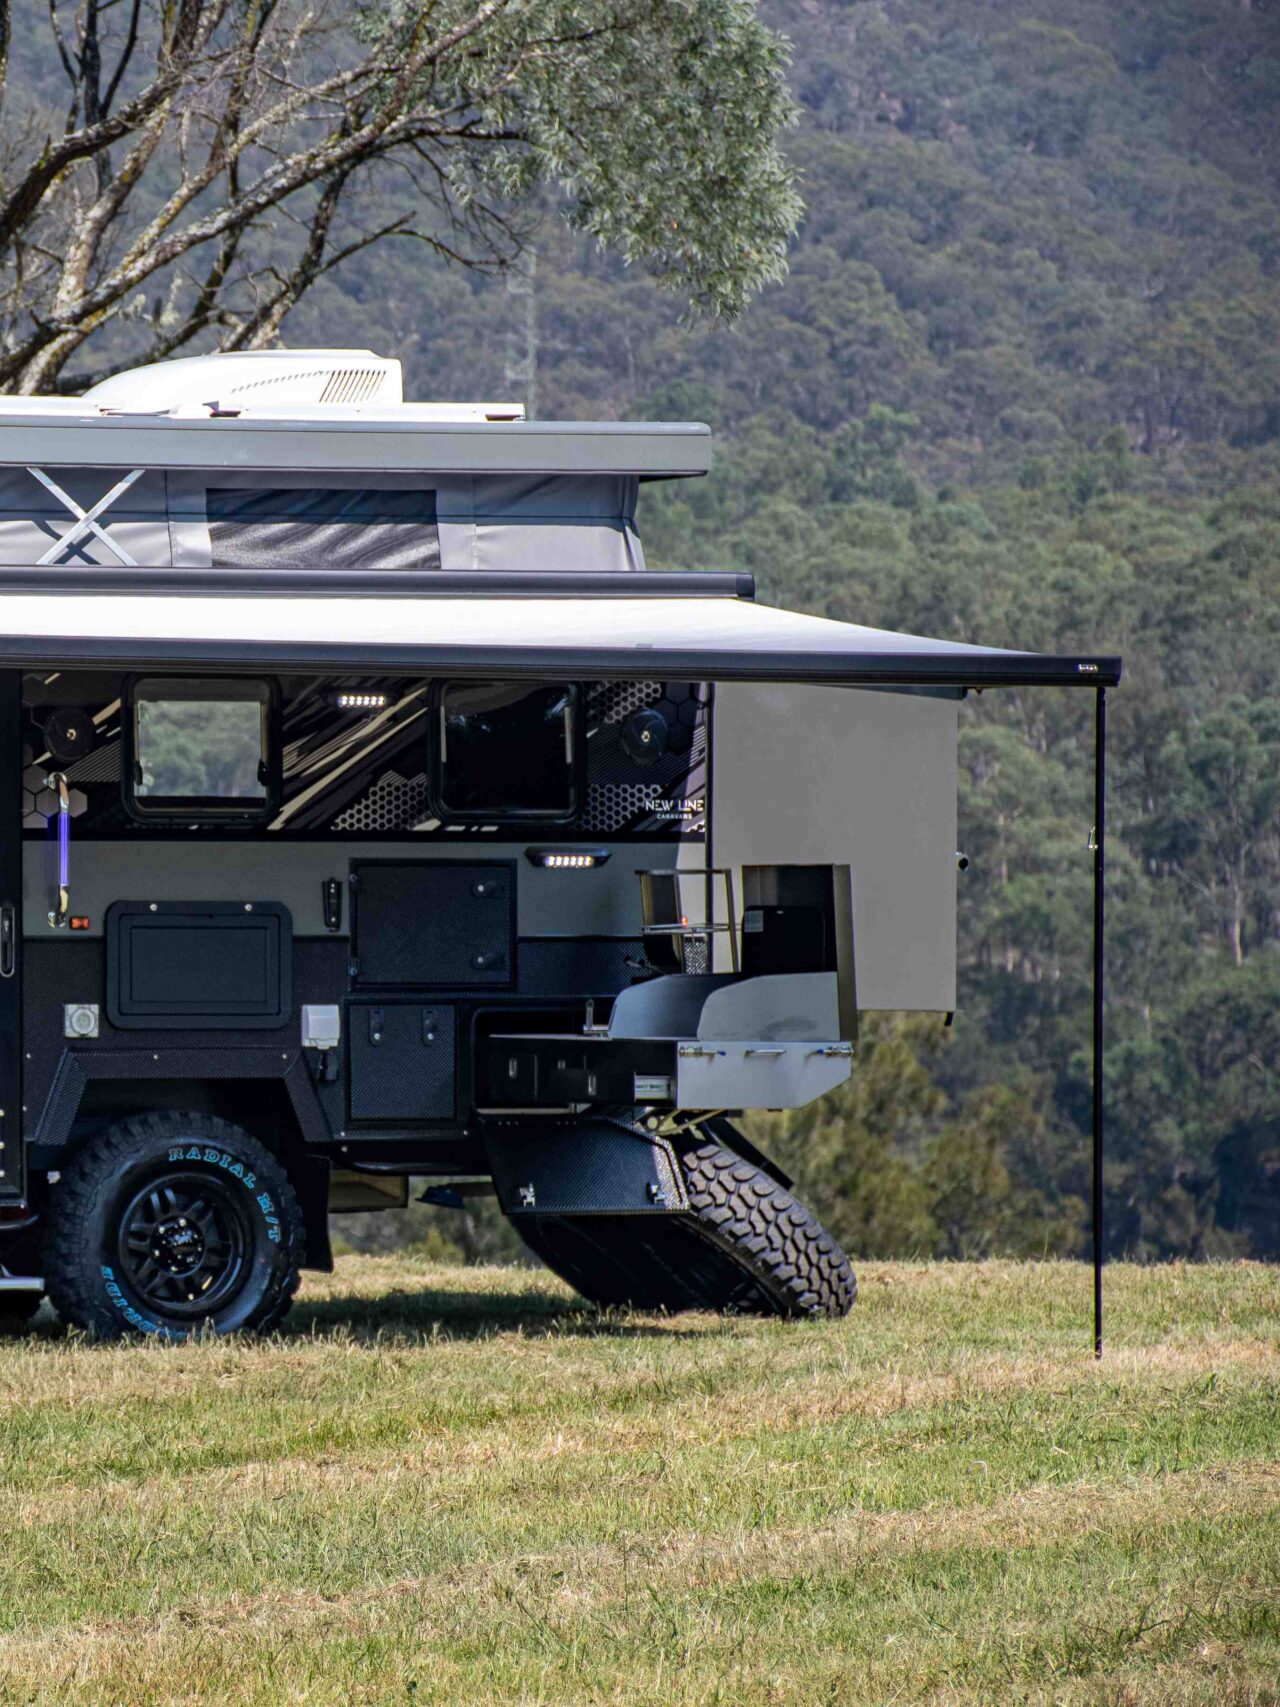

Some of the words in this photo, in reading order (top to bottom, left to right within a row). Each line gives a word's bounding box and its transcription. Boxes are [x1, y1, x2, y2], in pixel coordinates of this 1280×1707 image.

[645, 799, 674, 811] NEW
[678, 799, 704, 811] LINE
[168, 1146, 257, 1189] RADIAL
[256, 1192, 281, 1243] M/T
